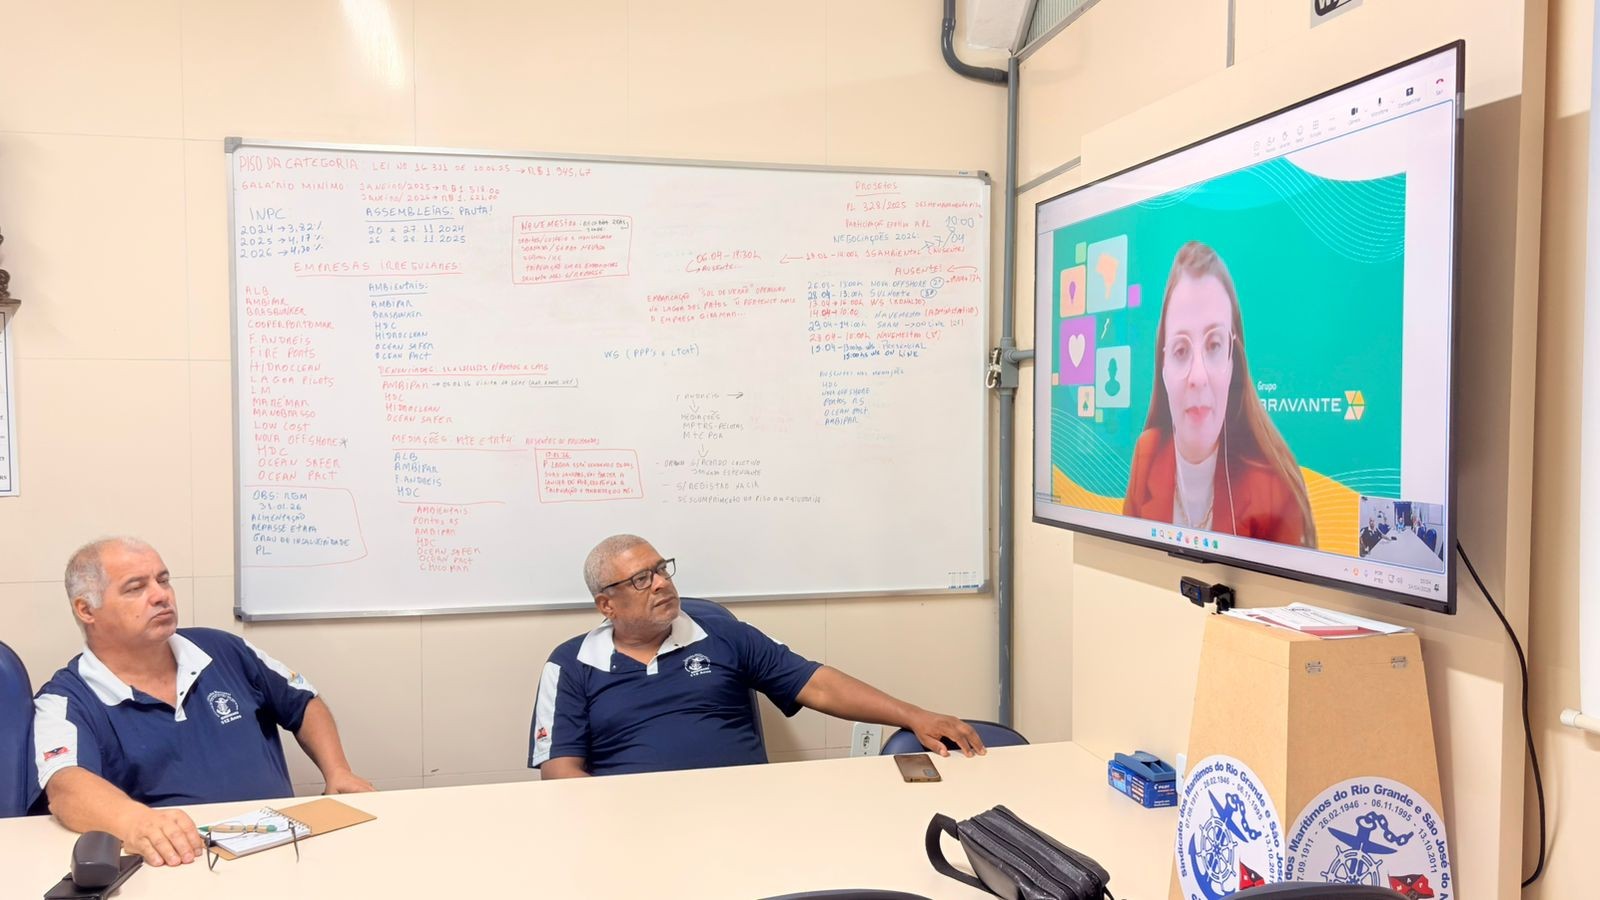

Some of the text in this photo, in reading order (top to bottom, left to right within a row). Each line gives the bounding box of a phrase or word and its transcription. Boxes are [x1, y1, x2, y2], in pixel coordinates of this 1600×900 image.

[240, 156, 262, 172] PISO
[267, 157, 281, 170] DA
[286, 158, 359, 170] CATEGORIA
[372, 162, 390, 171] LEI
[249, 208, 287, 220] INPC
[240, 224, 274, 236] 2024
[240, 237, 273, 246] 2025
[440, 235, 466, 244] 2025
[834, 232, 889, 245] NEGOCIAÇÕES
[294, 262, 370, 272] EMPRESAS
[246, 286, 270, 296] ALB
[250, 346, 278, 358] FIRE
[250, 360, 321, 373] HIDROCLEAN
[1257, 381, 1277, 392] Grupo
[386, 414, 416, 422] OCEAN
[254, 421, 310, 432] LOW COST
[255, 433, 280, 443] NOVA
[257, 445, 289, 457] HDC
[394, 452, 418, 462] ALB
[258, 458, 342, 469] OCEAN SAFER
[394, 462, 438, 474] AMBIPAR
[258, 470, 338, 481] OCEAN PACT
[397, 486, 420, 498] HDC
[256, 545, 272, 556] PL
[416, 547, 447, 556] OCEAN
[1214, 761, 1224, 772] do
[1226, 762, 1238, 776] Rio
[1240, 771, 1266, 808] Grande
[1179, 798, 1188, 818] dos
[1265, 810, 1271, 818] e
[1270, 820, 1280, 848] São
[1285, 784, 1450, 890] dos Marítimos do Rio Grande e São José do
[1318, 800, 1360, 830] 26.02.1946
[1371, 798, 1413, 822] 06.11.1995
[1418, 828, 1438, 874] 13.10.2011
[1178, 820, 1188, 878] Sindicato
